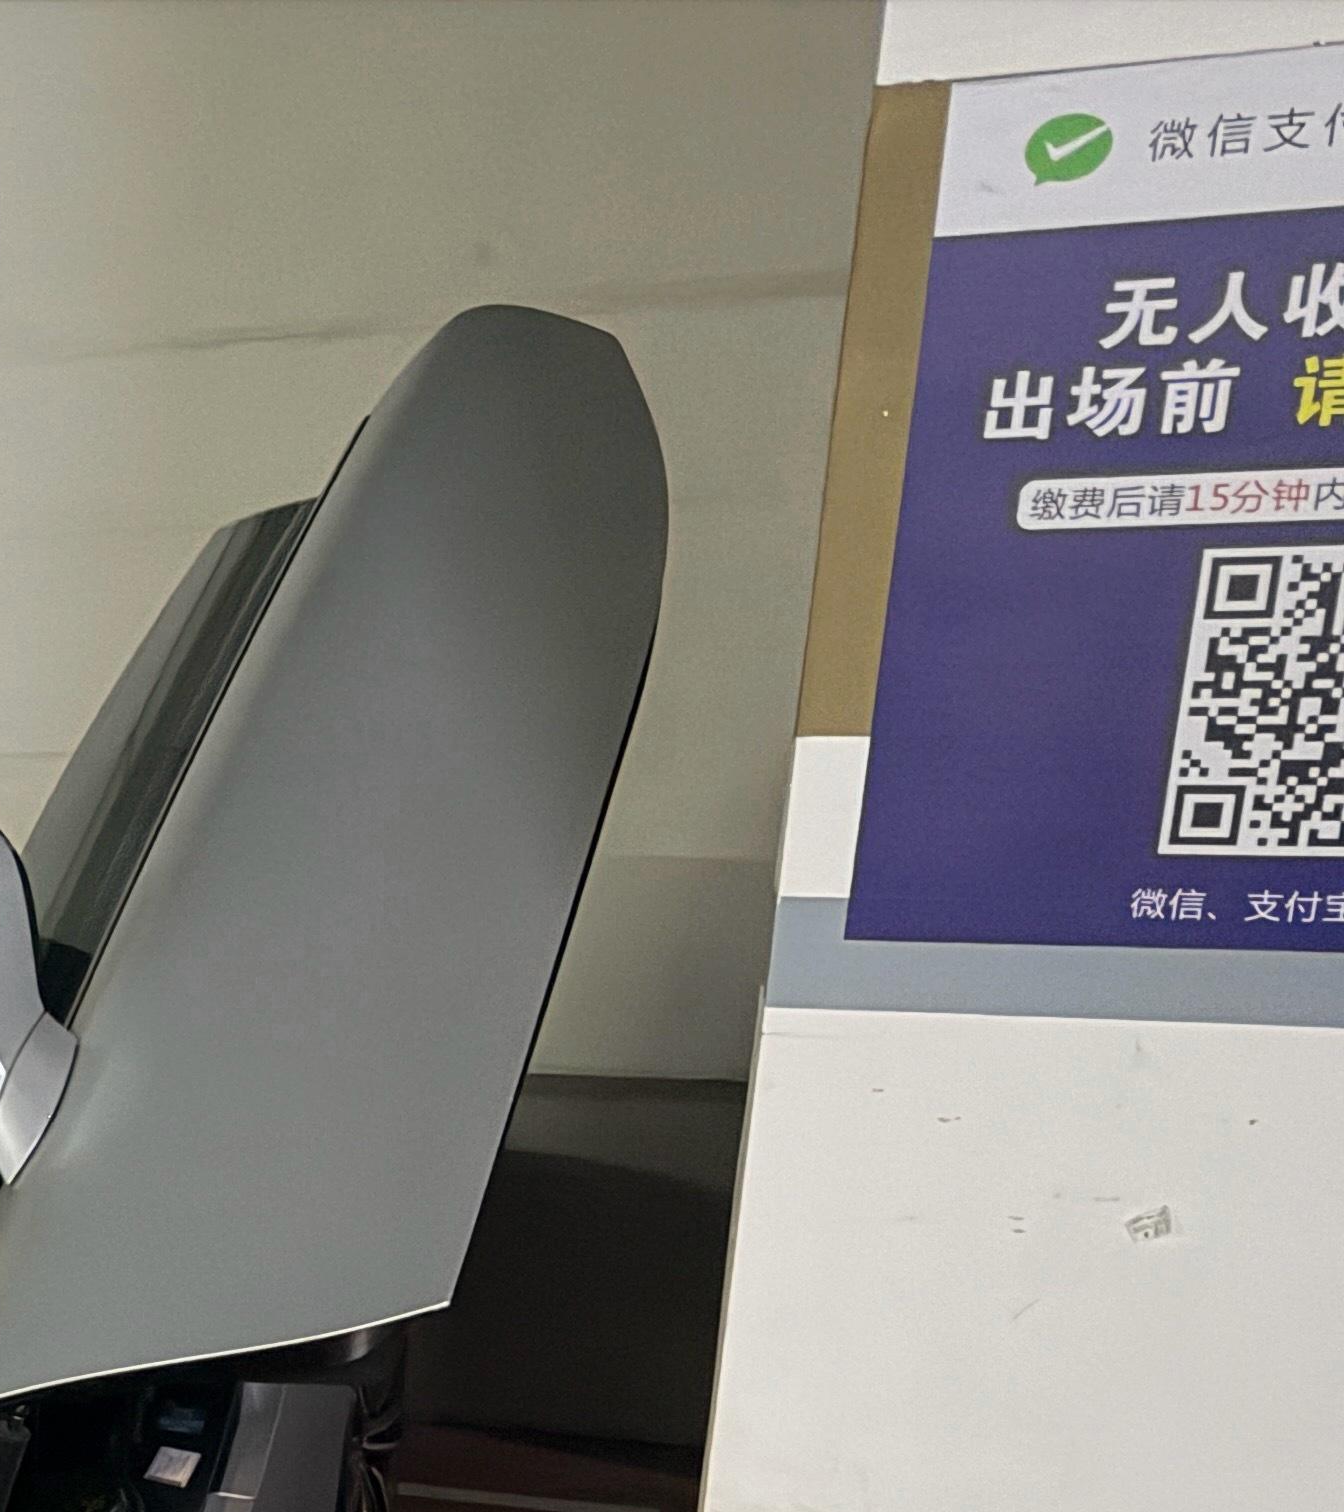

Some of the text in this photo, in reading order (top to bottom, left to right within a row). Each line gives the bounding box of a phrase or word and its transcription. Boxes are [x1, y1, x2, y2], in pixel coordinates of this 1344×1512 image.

[1098, 262, 1344, 349] 无人收
[983, 356, 1344, 440] 出场前 请
[1028, 476, 1344, 520] 缴费后请15分钟内
